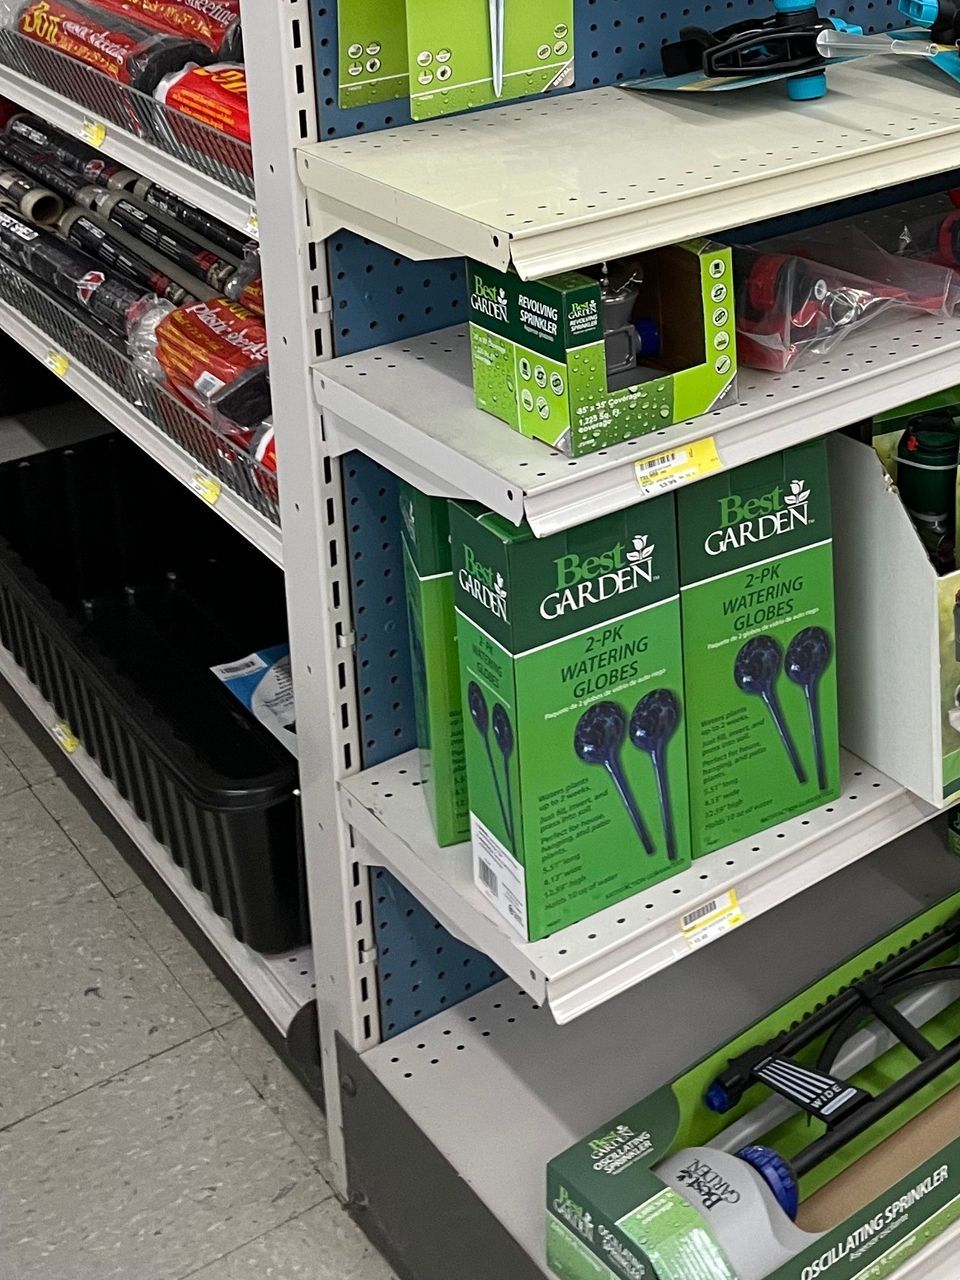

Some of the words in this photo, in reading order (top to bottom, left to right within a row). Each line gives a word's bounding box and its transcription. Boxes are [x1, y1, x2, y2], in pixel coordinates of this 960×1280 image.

[473, 274, 498, 298] Best
[470, 293, 508, 323] GARDEN
[518, 294, 558, 320] REVOLVING
[519, 309, 558, 336] SPRINKLER
[568, 307, 597, 320] GARDEN
[569, 313, 598, 327] REVOLVING
[571, 301, 589, 313] Best
[569, 319, 598, 333] SPRINKLER
[608, 391, 643, 407] Coverage
[578, 419, 612, 434] coverage
[718, 485, 784, 528] Best
[704, 500, 809, 556] GARDEN
[463, 543, 494, 589] Best
[553, 541, 626, 591] Best
[744, 563, 781, 588] 2-PK
[458, 569, 508, 623] GARDEN
[540, 556, 654, 620] GARDEN
[722, 575, 803, 617] WATERING
[734, 598, 794, 632] GLOBES
[584, 624, 624, 654] 2-PK
[561, 635, 649, 683] WATERING
[573, 660, 639, 699] GLOBES
[810, 1082, 843, 1109] WIDE
[592, 1131, 652, 1171] OSCILLATING
[604, 1139, 653, 1175] SPRINKLER
[685, 1178, 724, 1213] Best
[686, 1157, 742, 1205] GARDEN
[800, 1215, 884, 1280] OSCILLATING
[884, 1163, 950, 1225] SPRINKLER
